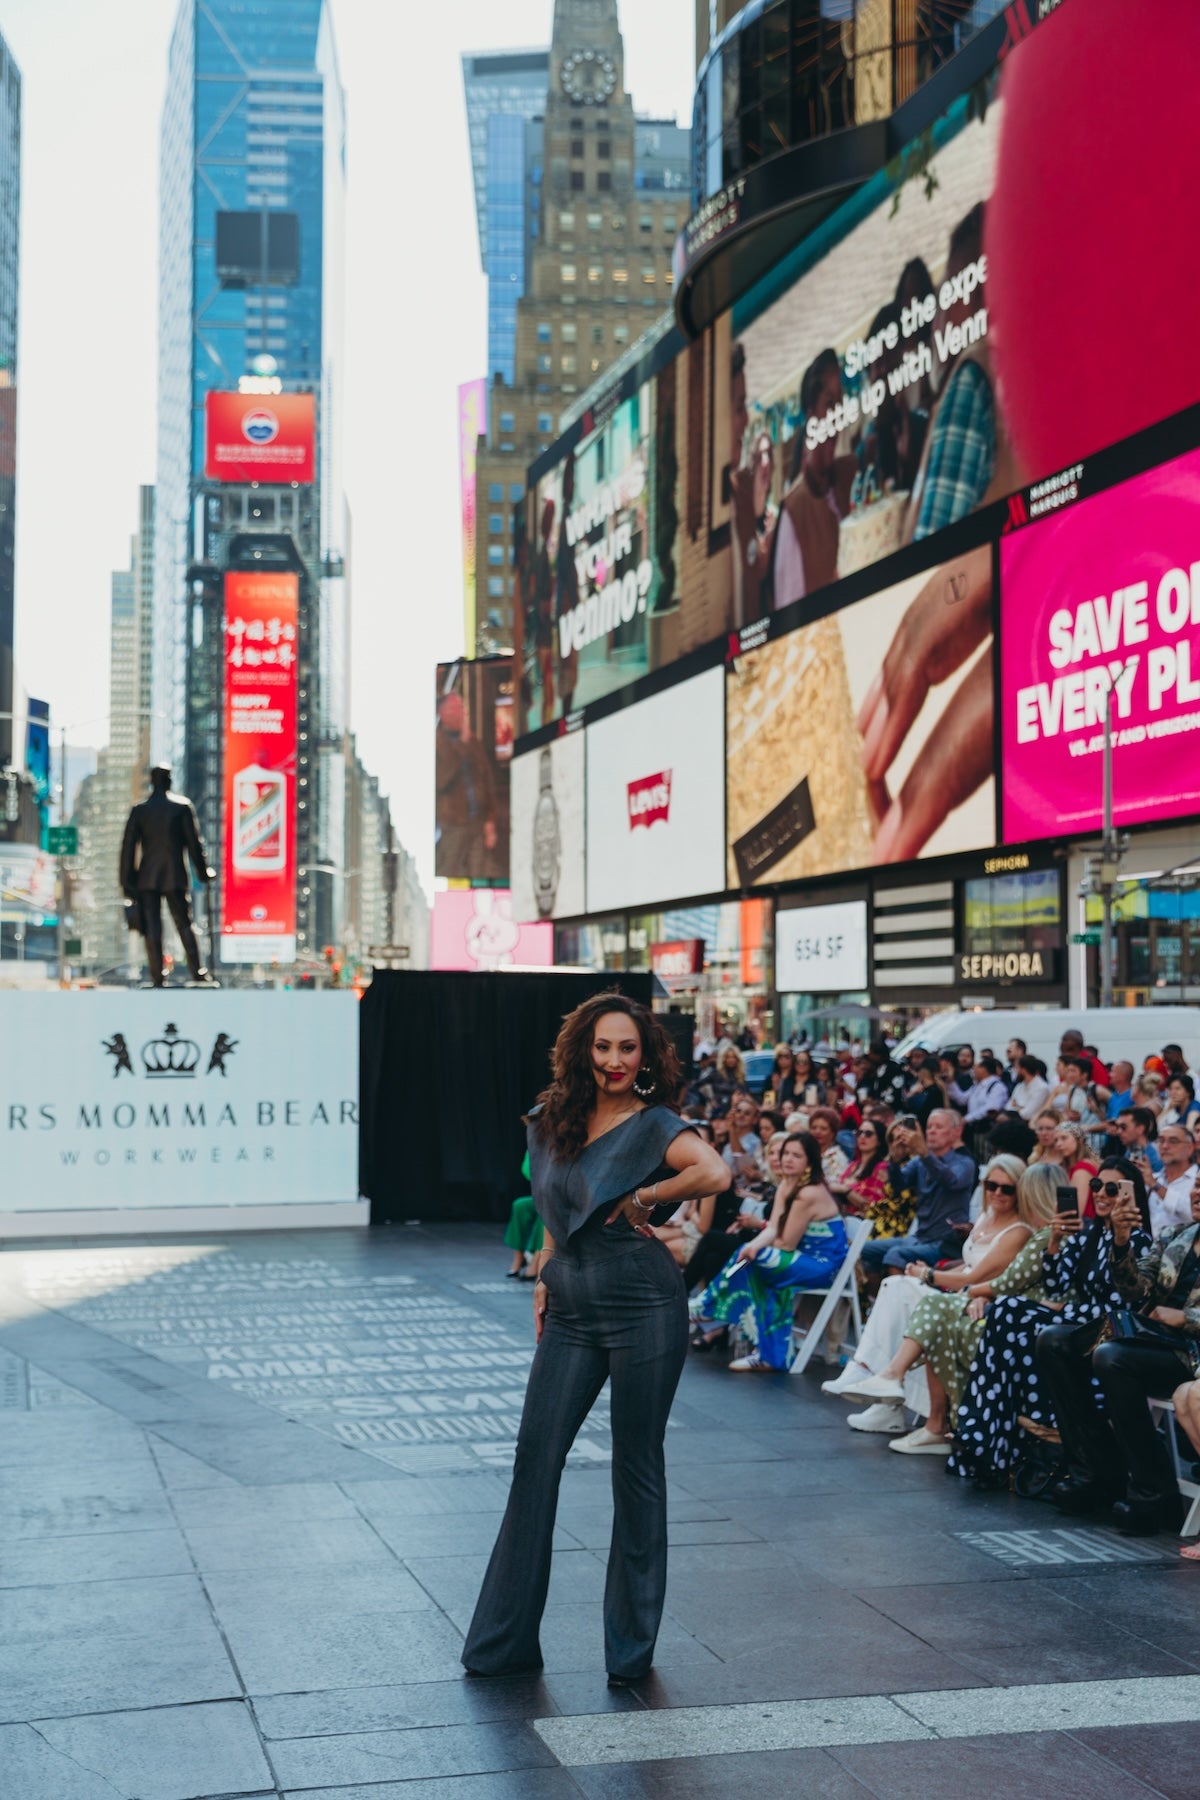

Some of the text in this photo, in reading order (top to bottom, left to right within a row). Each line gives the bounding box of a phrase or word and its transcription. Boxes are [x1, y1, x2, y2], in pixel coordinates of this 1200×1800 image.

[687, 179, 746, 234] MARRIOTT
[687, 203, 737, 254] MARQUIS
[844, 320, 898, 378] Share
[900, 293, 937, 338] the
[805, 395, 859, 450] Settle
[861, 379, 885, 417] up
[888, 341, 932, 396] with
[1030, 463, 1084, 501] MARRIOTT
[1030, 483, 1078, 517] MARQUIS
[574, 522, 632, 587] YOUR
[1049, 580, 1148, 669] SAVE
[1017, 655, 1140, 744] EVERY
[1117, 726, 1146, 747] AND
[984, 854, 1029, 874] SEPHORA
[961, 951, 1044, 979] SEPHORA
[76, 1101, 238, 1129] MOMMA
[256, 1099, 360, 1127] BEAR
[60, 1147, 274, 1166] WORKWEAR
[203, 1342, 345, 1361] KERR
